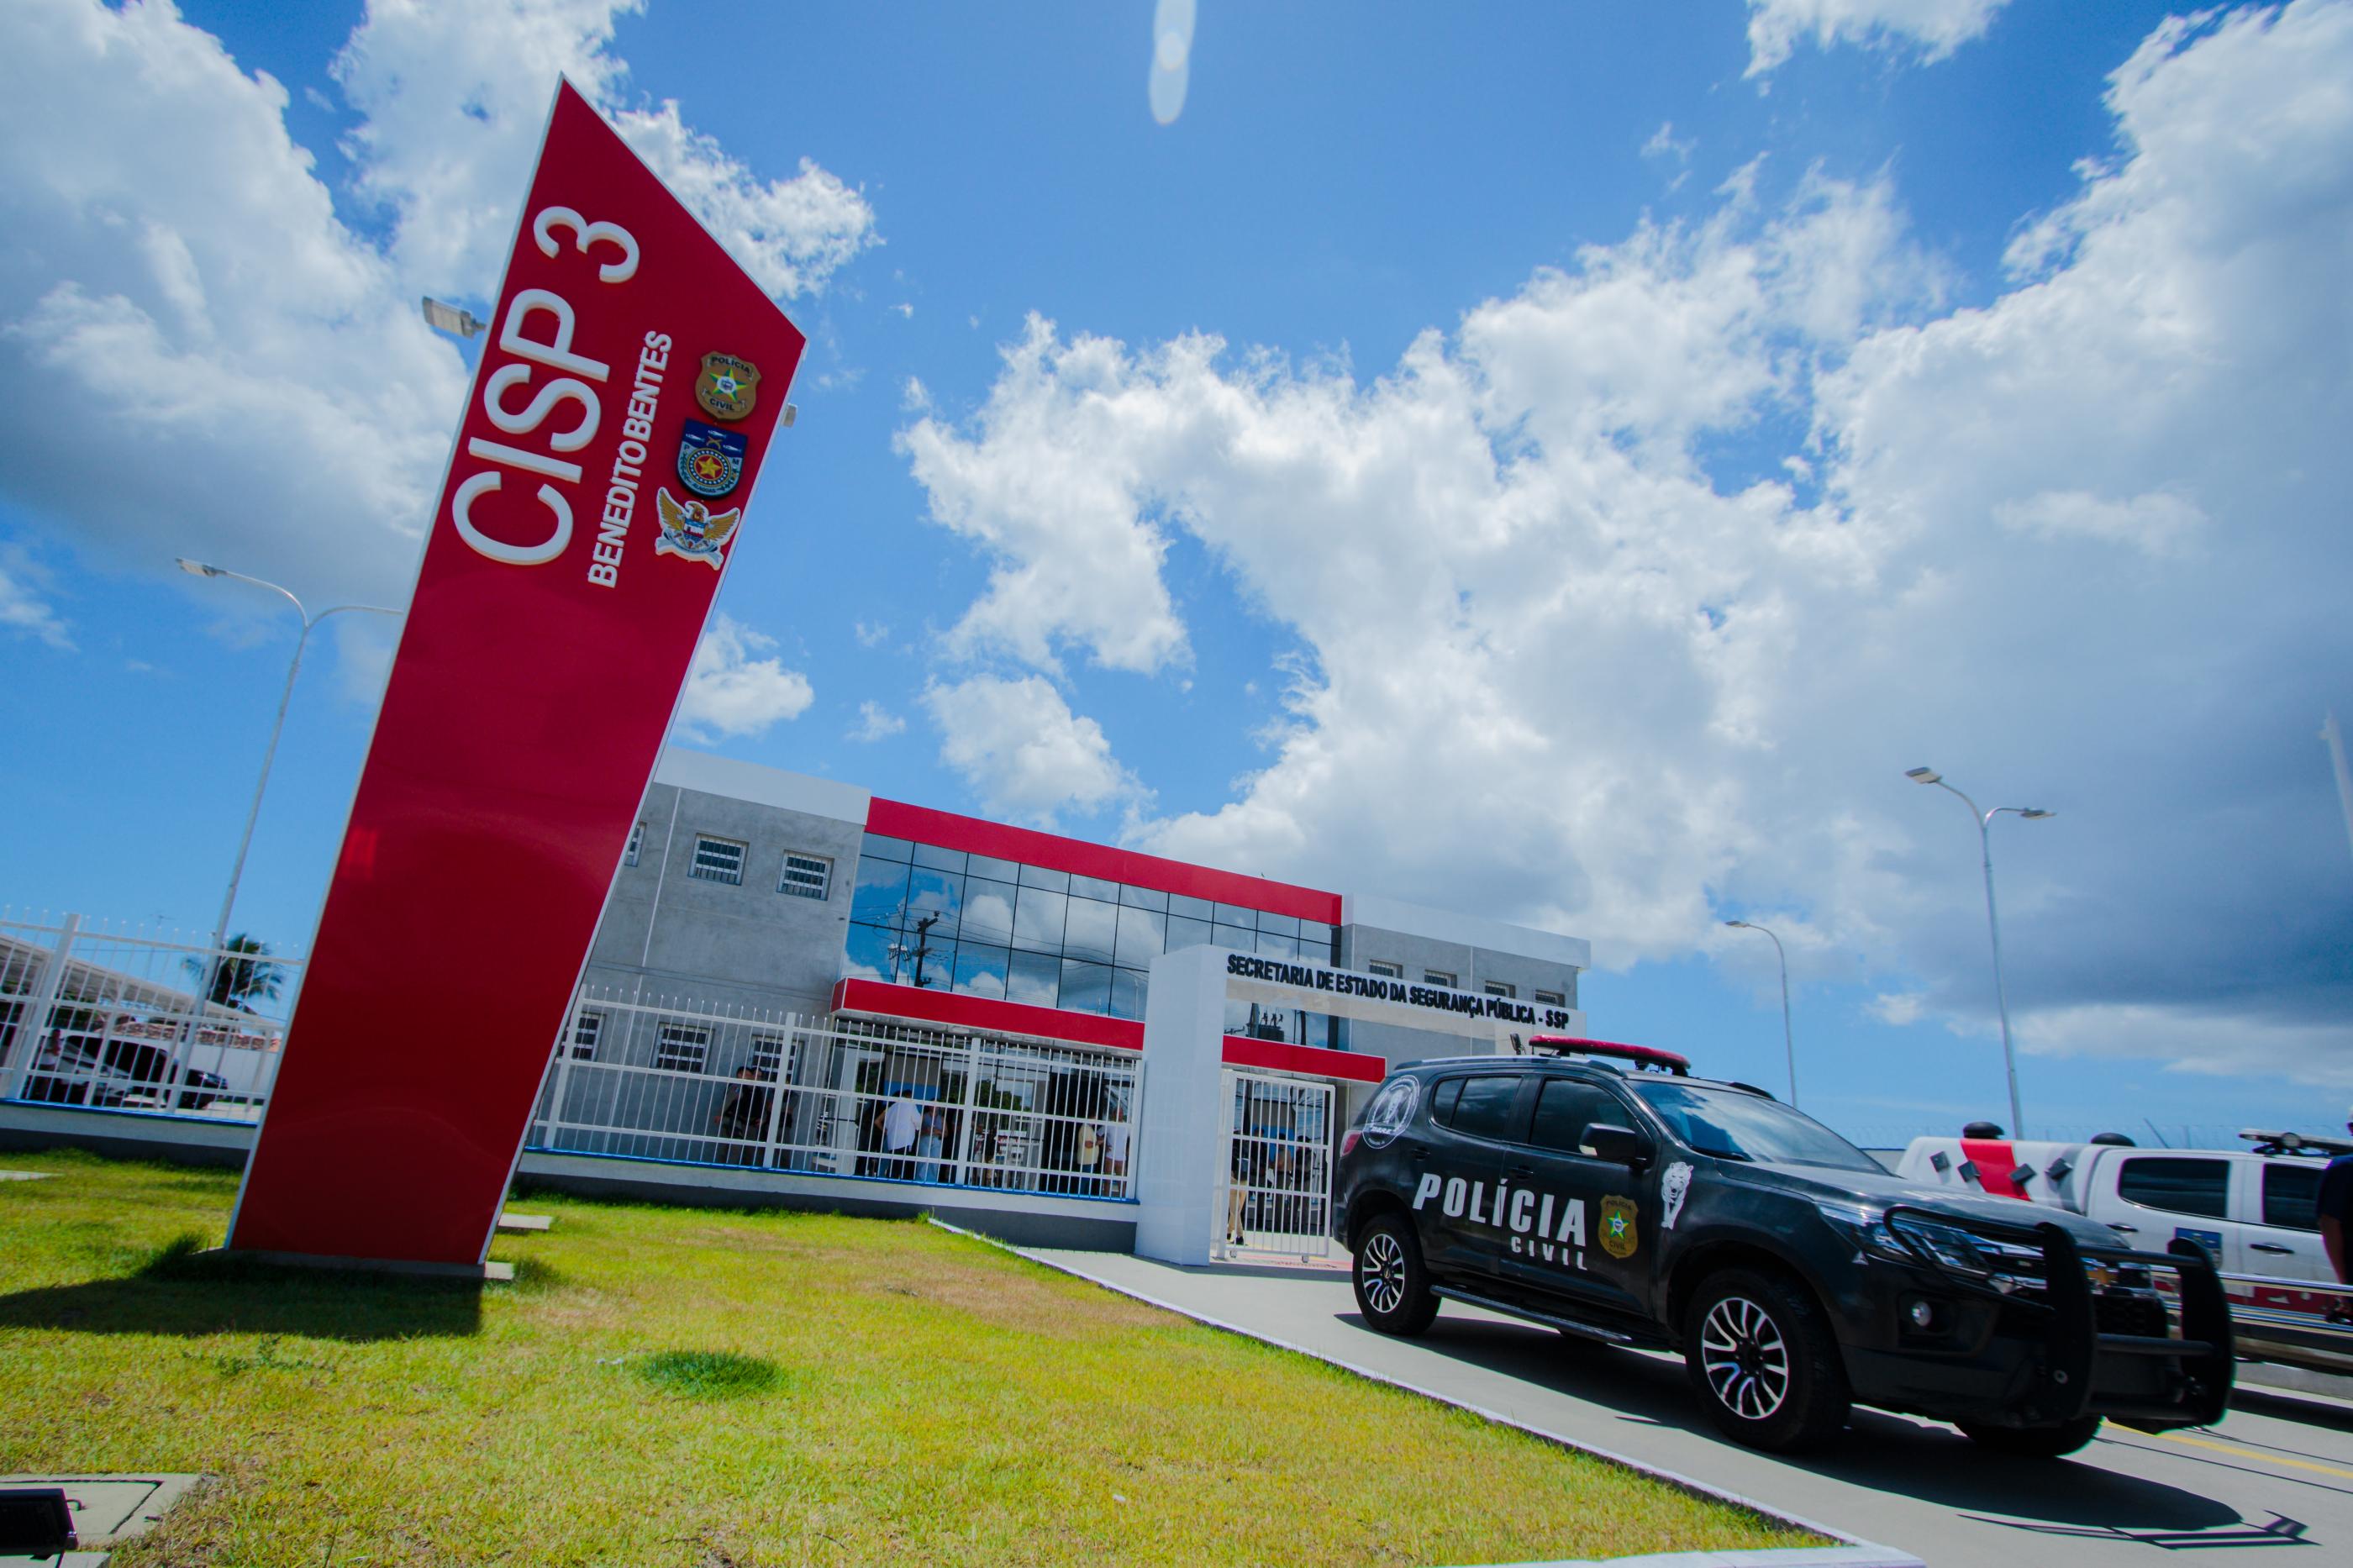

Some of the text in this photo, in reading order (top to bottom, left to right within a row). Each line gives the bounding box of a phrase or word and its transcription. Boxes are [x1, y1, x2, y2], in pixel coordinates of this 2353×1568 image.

[452, 206, 640, 566] CISP 3
[709, 397, 734, 411] CIVIL
[1227, 954, 1313, 988] SECRETARIA
[1316, 970, 1334, 992] DE
[1335, 974, 1387, 1000] ESTADO
[1390, 982, 1408, 1003] DA
[1409, 986, 1484, 1018] SEGURANÇA
[1486, 997, 1536, 1025] PÚBLICA
[1545, 1009, 1569, 1029] SSP
[1413, 1172, 1587, 1247] POLÍCIA
[1511, 1236, 1587, 1271] CIVIL
